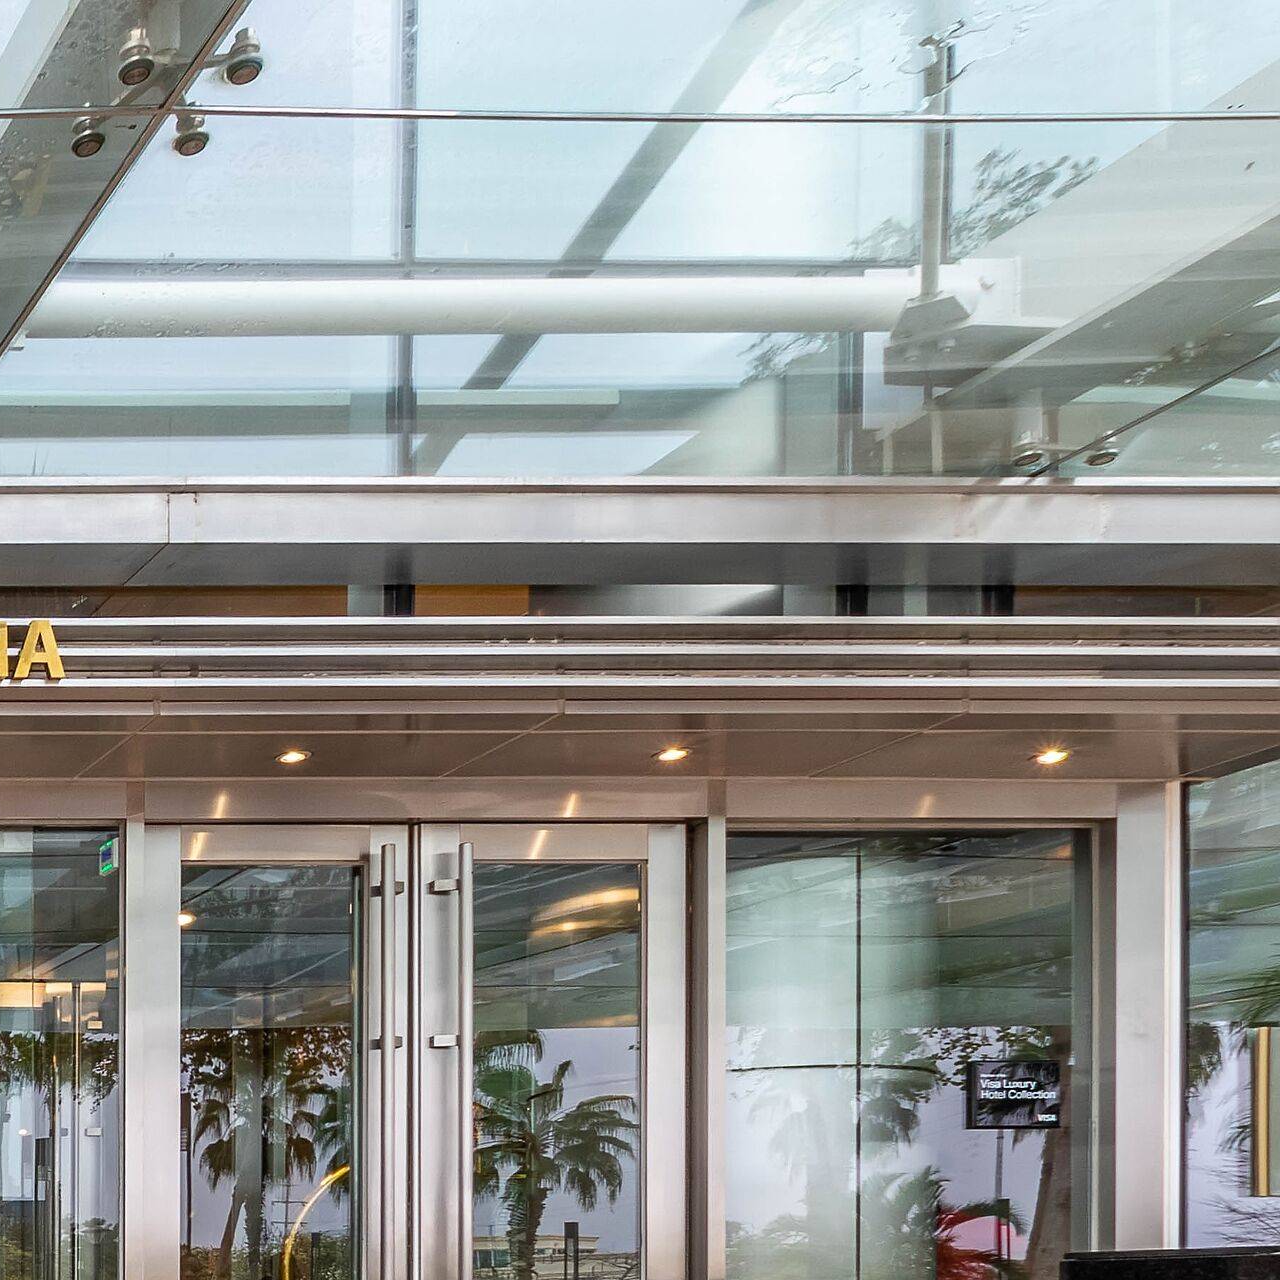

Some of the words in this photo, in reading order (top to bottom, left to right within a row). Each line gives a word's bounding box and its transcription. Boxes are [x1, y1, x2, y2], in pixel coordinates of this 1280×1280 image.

[980, 1079, 1001, 1089] Visa
[1003, 1079, 1037, 1090] Luxury
[980, 1089, 1006, 1099] Hotel
[1007, 1089, 1056, 1099] Collection
